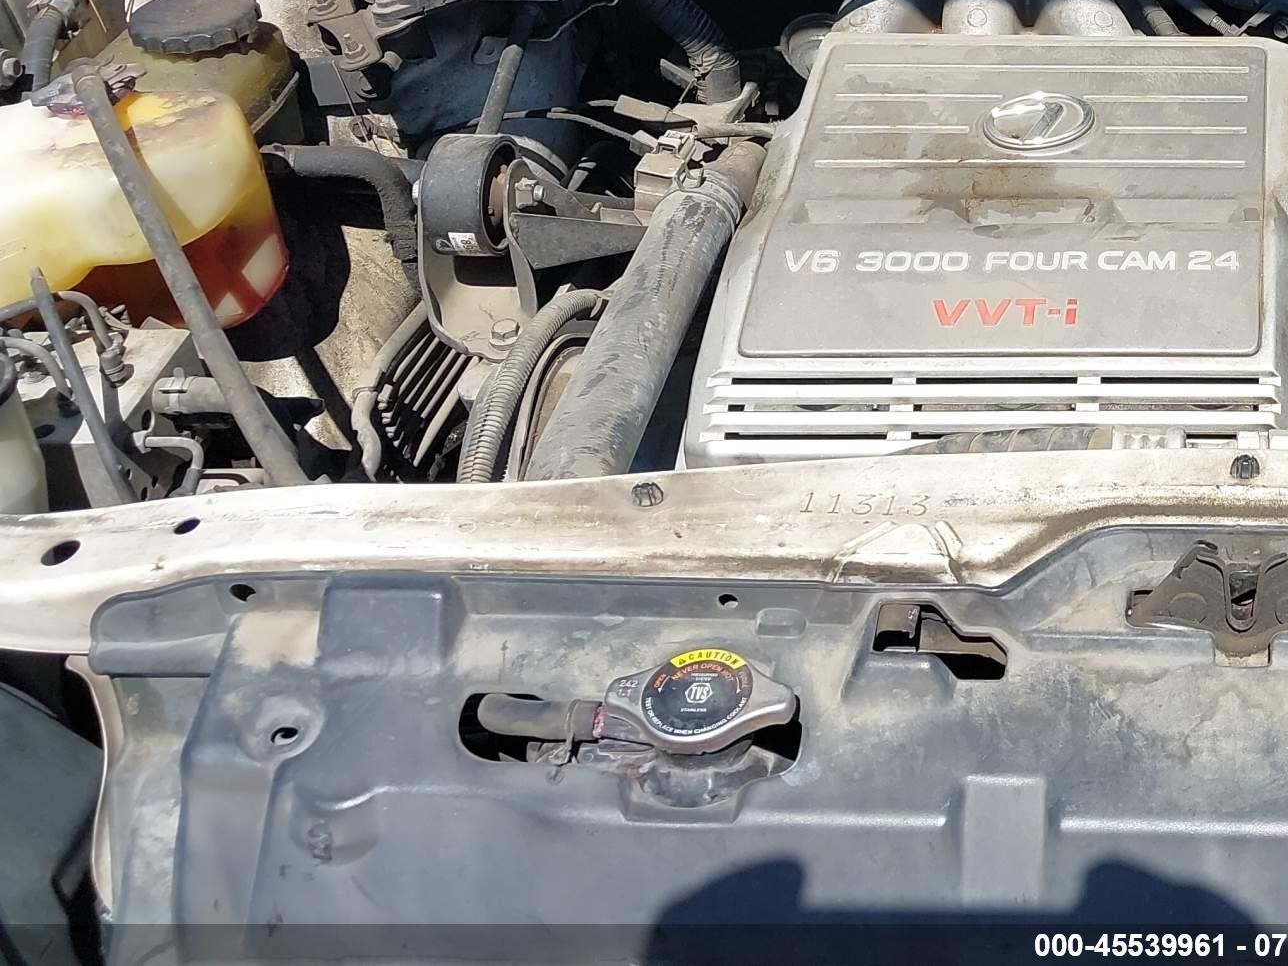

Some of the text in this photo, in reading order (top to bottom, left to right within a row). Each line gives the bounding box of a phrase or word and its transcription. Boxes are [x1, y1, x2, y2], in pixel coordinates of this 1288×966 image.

[784, 249, 1240, 273] V6 3000 FOUR CAM 24
[932, 298, 1079, 327] VVT-i
[800, 492, 931, 516] 11313
[688, 650, 740, 666] CAUTION
[671, 663, 699, 680] NEVER
[700, 663, 722, 673] OPEN
[690, 686, 709, 700] TVS
[651, 716, 674, 733] REPLACE
[693, 719, 727, 734] CHANGING
[726, 697, 748, 720] COOLANT
